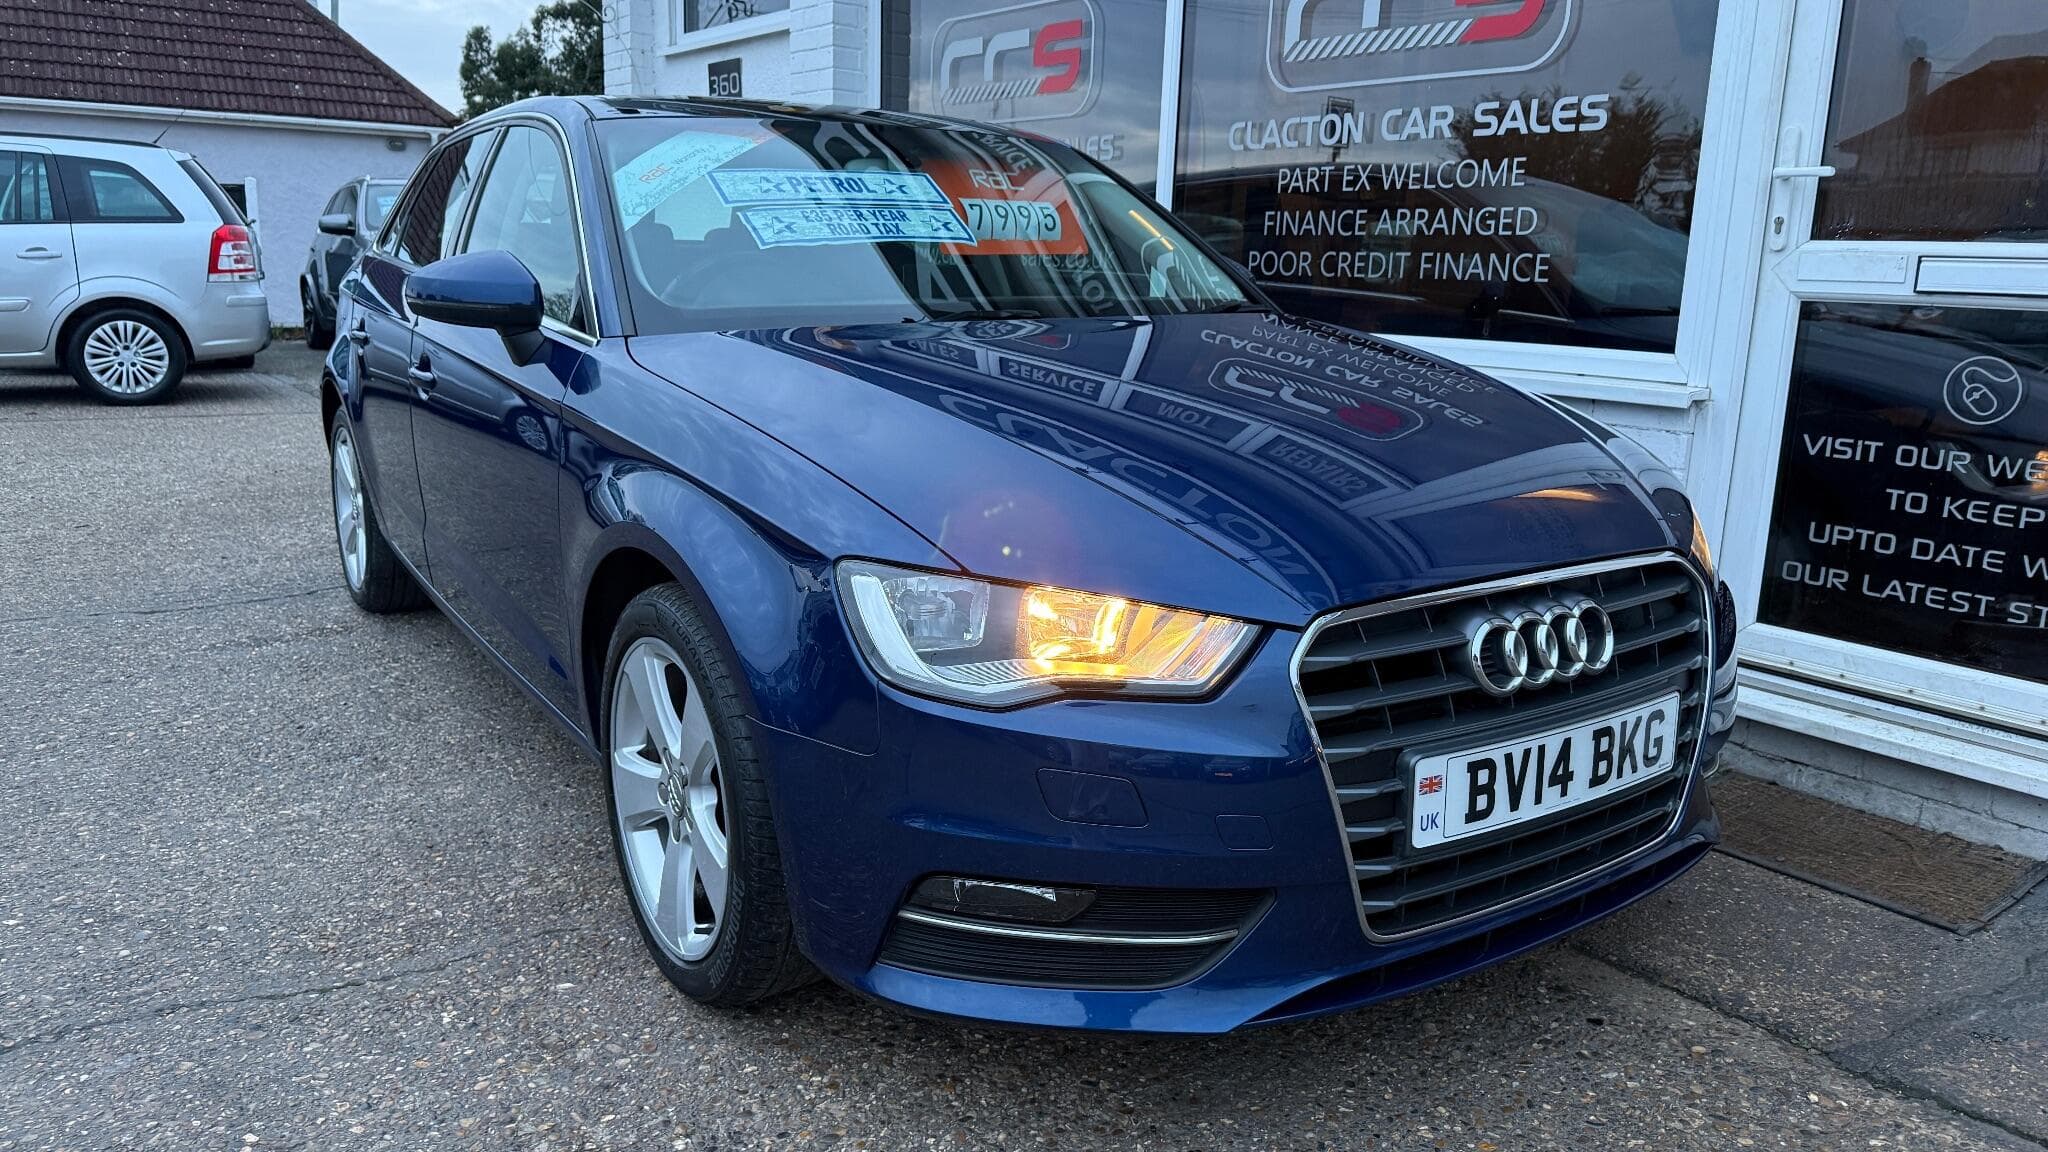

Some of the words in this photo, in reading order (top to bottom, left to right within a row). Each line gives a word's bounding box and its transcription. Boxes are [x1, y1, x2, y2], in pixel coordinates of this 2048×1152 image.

[710, 72, 740, 97] 360
[1229, 112, 1365, 151] CLACTON
[1381, 105, 1455, 141] CAR
[1473, 94, 1609, 137] SALES
[787, 175, 876, 195] PETROL
[1277, 165, 1335, 193] PART
[1342, 163, 1373, 191] EX
[1381, 157, 1527, 190] WELCOME
[802, 208, 832, 222] £35
[834, 209, 864, 222] PER
[868, 209, 908, 223] YEAR
[829, 222, 868, 236] ROAD
[874, 222, 905, 236] TAX
[968, 203, 1057, 232] 7995
[1264, 209, 1368, 236] FINANCE
[1375, 206, 1538, 236] ARRANGED
[1249, 250, 1312, 277] POOR
[1320, 251, 1411, 279] CREDIT
[1419, 252, 1550, 283] FINANCE
[1803, 433, 1883, 462] VISIT
[1895, 445, 1971, 475] OUR
[1886, 488, 1928, 514] TO
[1943, 496, 2046, 529] KEEP
[1808, 522, 1896, 554] UPTO
[1911, 537, 2006, 573] DATE
[1782, 560, 1849, 591] OUR
[1861, 574, 1995, 617] LATEST
[1464, 737, 1575, 824] BV14
[1588, 709, 1666, 789] BKG
[1419, 811, 1440, 832] UK
